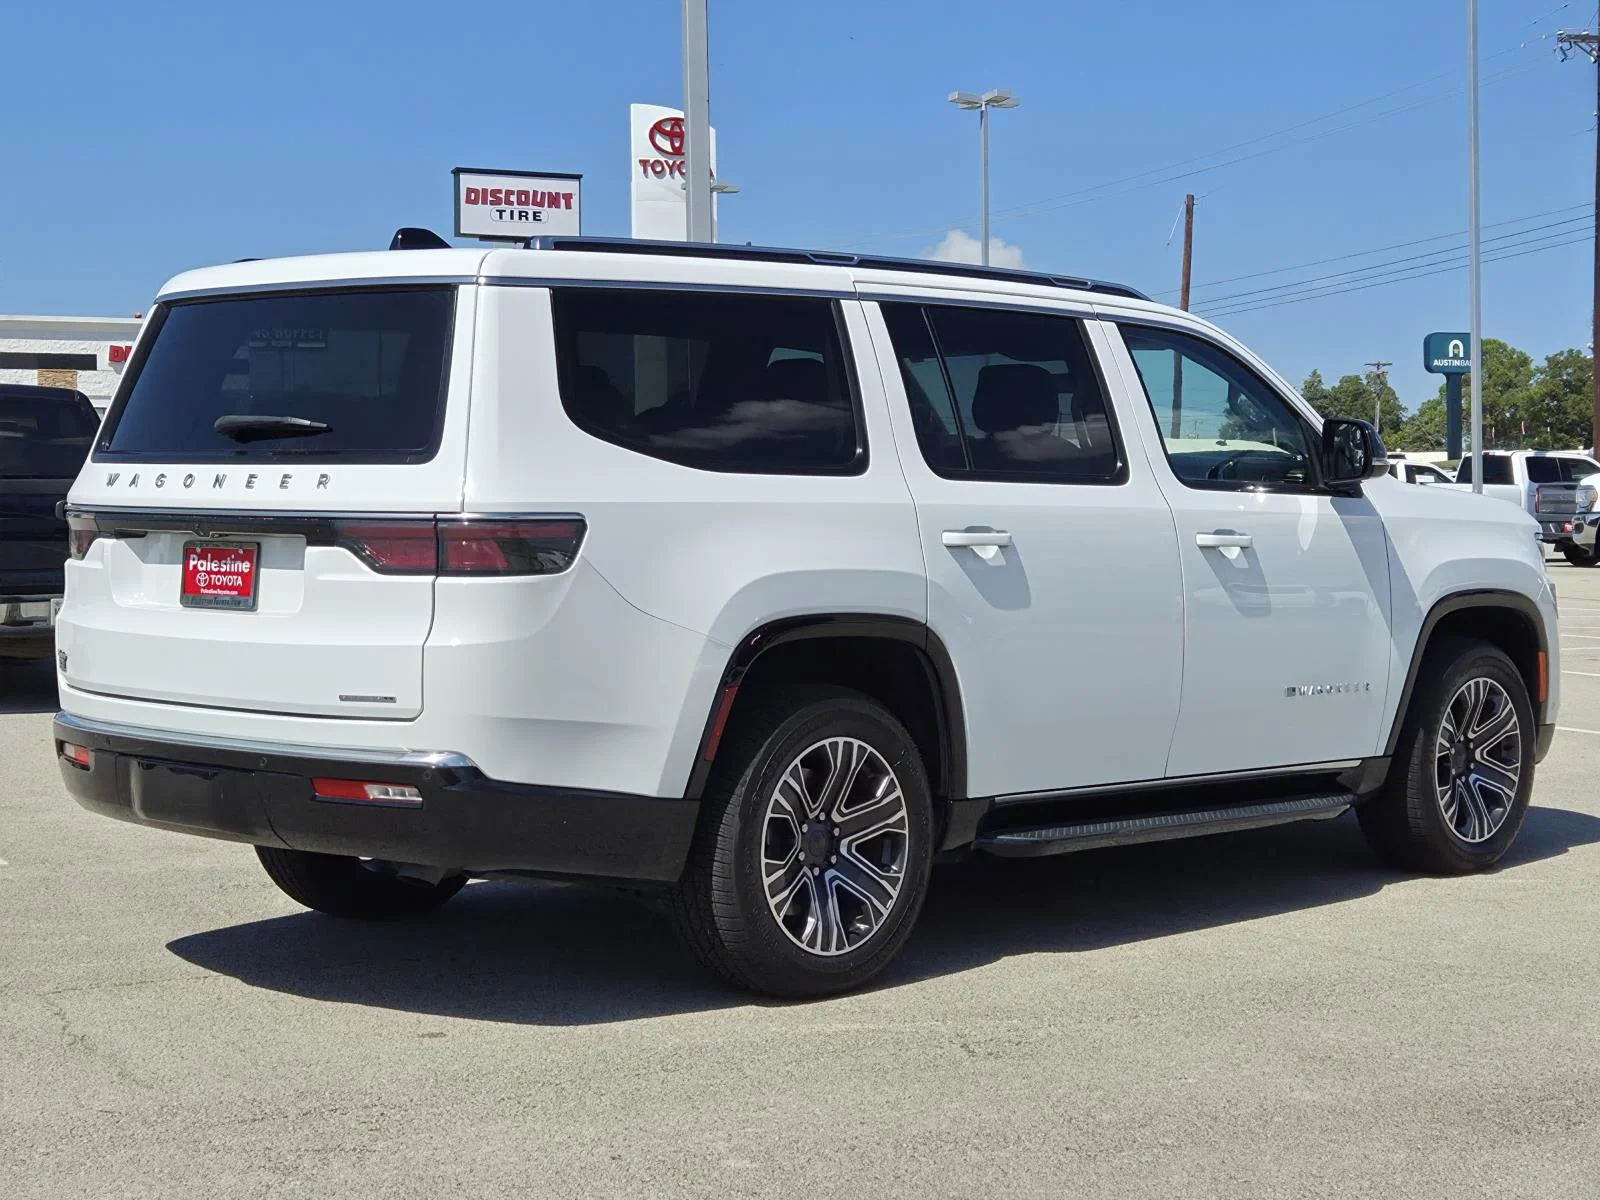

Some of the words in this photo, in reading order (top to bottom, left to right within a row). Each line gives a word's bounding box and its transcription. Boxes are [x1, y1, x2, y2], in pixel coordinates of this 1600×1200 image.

[465, 187, 573, 210] DISCOUNT
[496, 209, 542, 221] TIRE
[1433, 359, 1472, 367] AUSTINBA
[106, 473, 330, 490] WAGONEER
[189, 553, 251, 573] Palestine
[210, 575, 243, 587] TOYOTA
